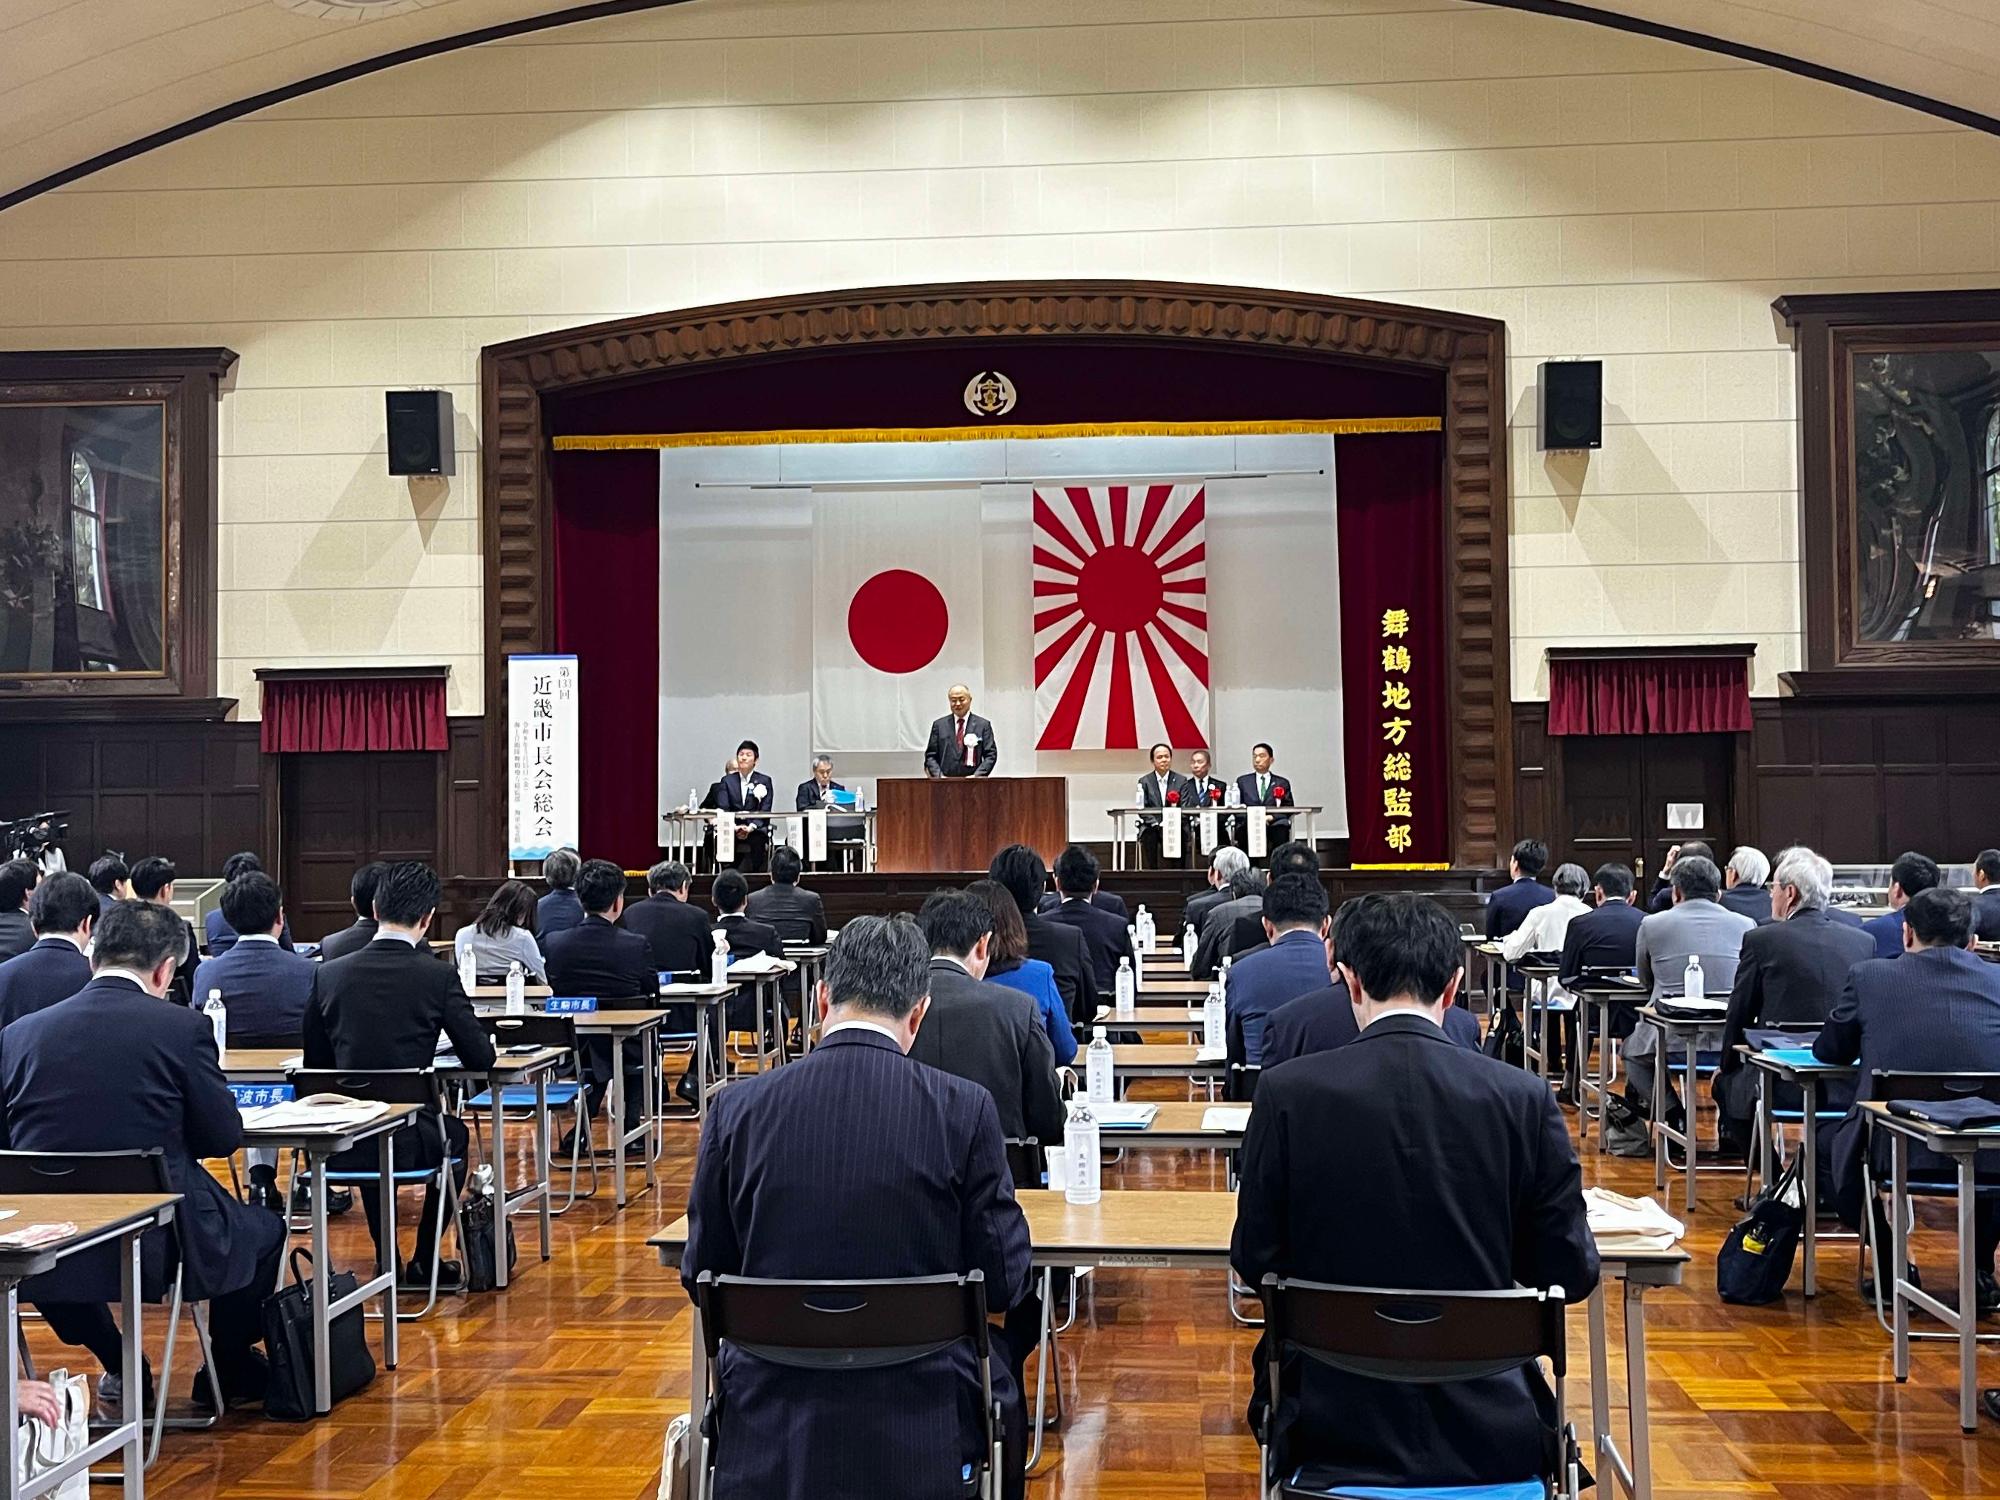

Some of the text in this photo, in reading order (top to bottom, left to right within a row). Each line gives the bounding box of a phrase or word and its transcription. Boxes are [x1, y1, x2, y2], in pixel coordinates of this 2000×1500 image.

[532, 675, 554, 837] 近畿市長会総会
[1381, 608, 1413, 854] 舞鶴地方総監部
